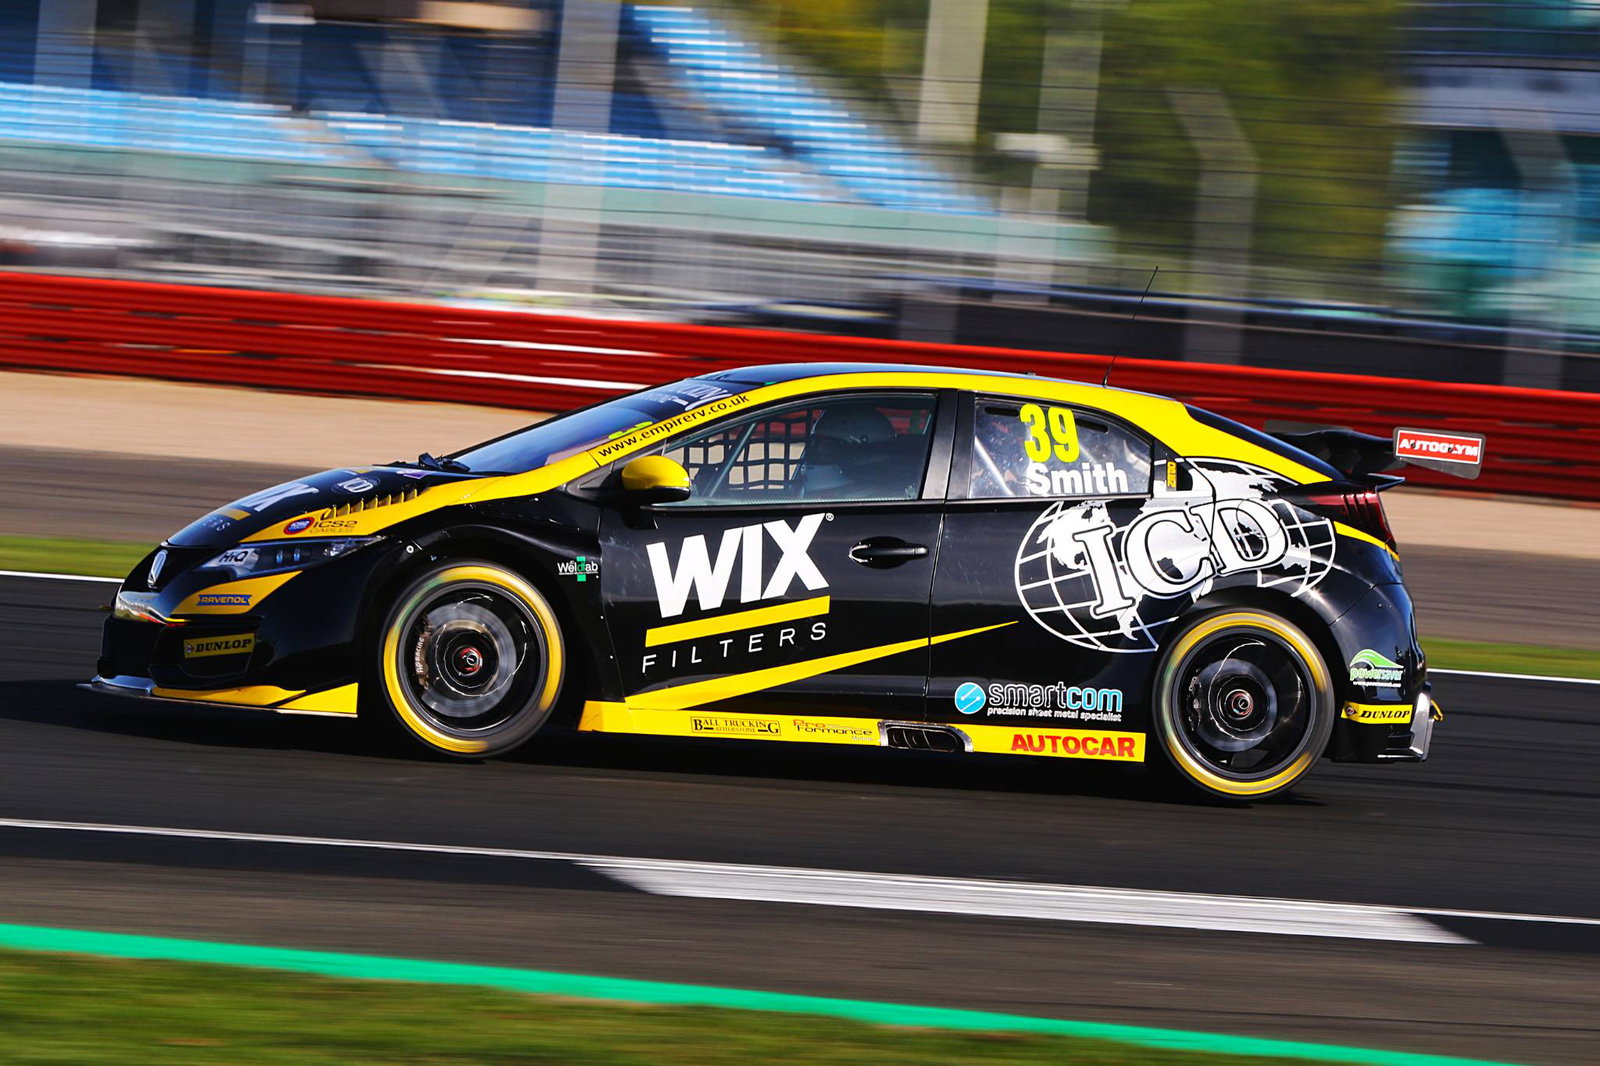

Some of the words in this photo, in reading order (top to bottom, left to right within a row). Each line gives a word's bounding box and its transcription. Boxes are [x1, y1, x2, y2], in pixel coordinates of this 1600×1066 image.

[598, 393, 750, 457] www.empirerv.co.uk
[1019, 403, 1081, 463] 39
[1026, 461, 1129, 496] Smith
[1072, 497, 1291, 620] ICD
[201, 596, 249, 604] RAVENOL
[196, 639, 252, 653] DUNLOP
[642, 622, 828, 674] FILTERS
[989, 681, 1123, 713] smartcom
[793, 719, 826, 728] Pro
[987, 707, 1026, 717] precision
[1028, 708, 1052, 718] sheet
[1054, 710, 1079, 719] metal
[1080, 712, 1122, 722] specialist
[1358, 710, 1410, 719] DUNLOP
[1011, 733, 1136, 758] AUTOCAR
